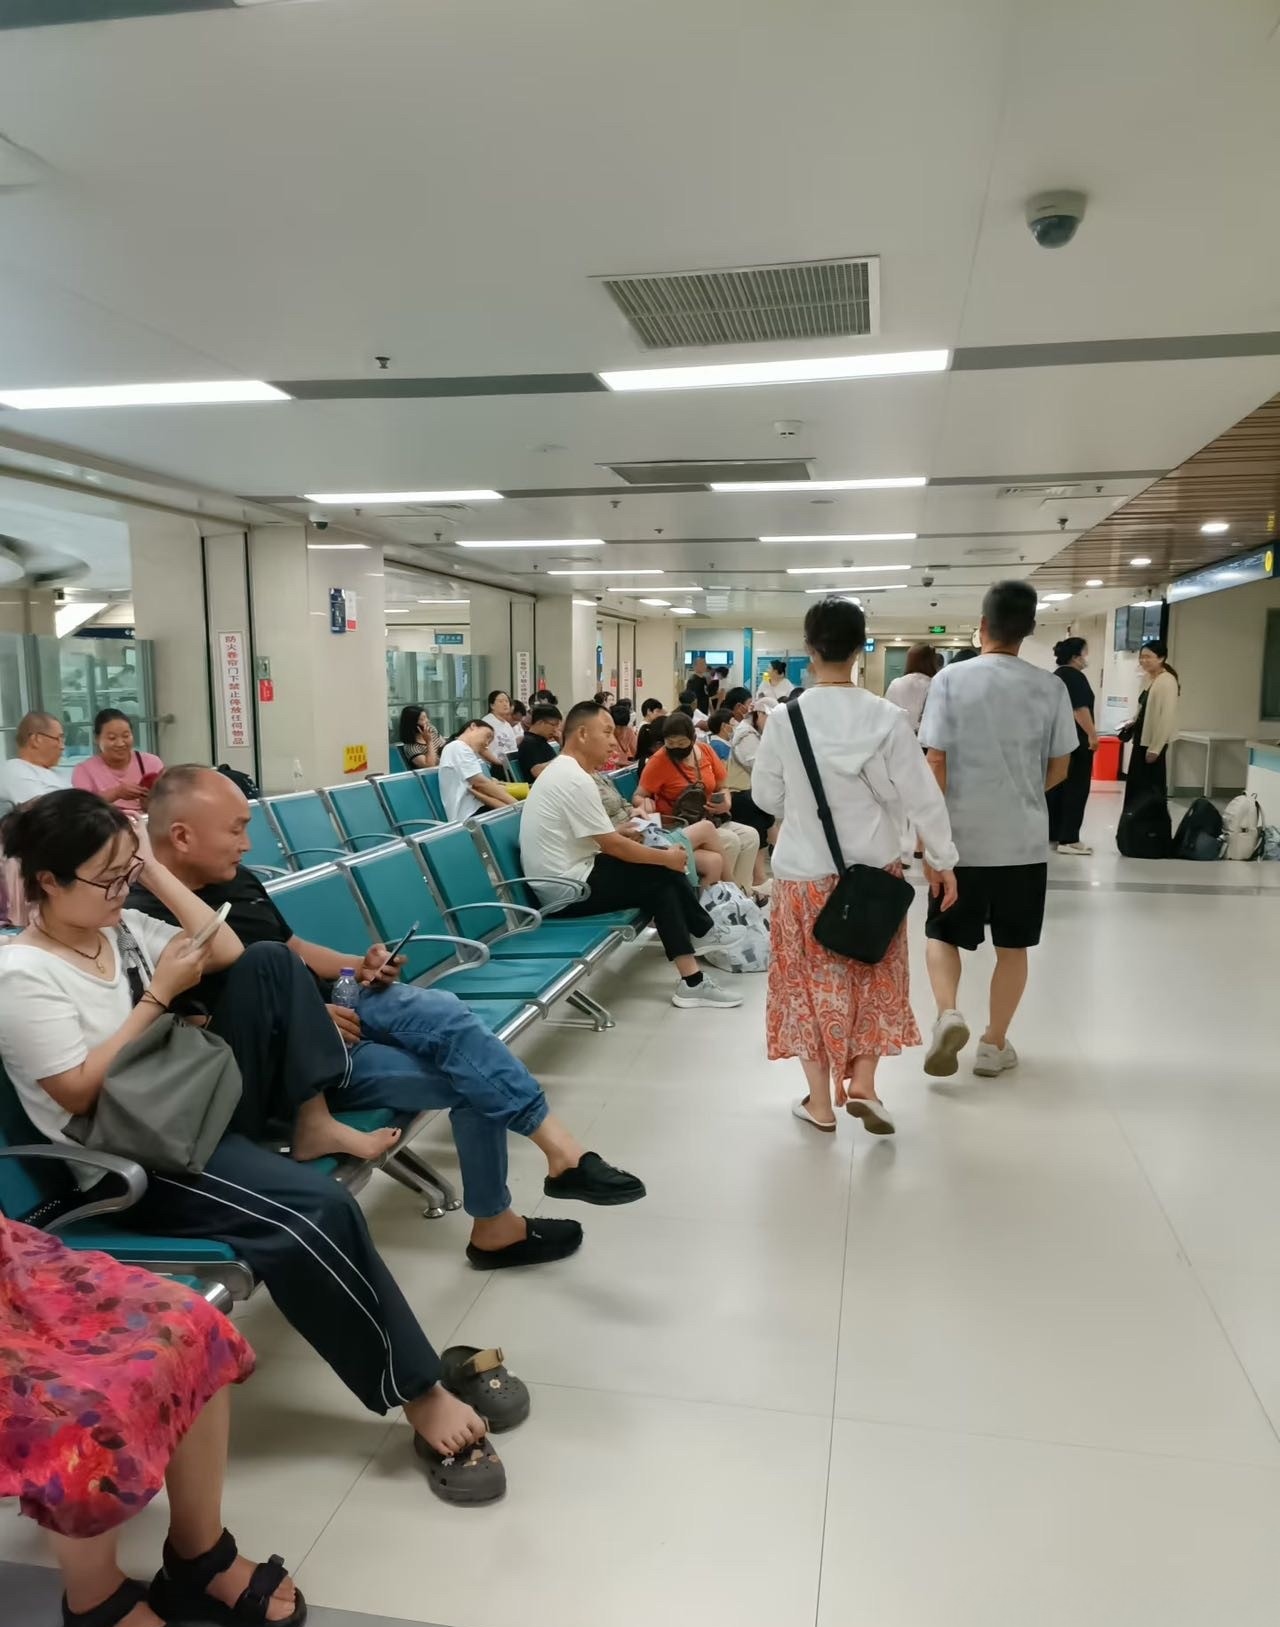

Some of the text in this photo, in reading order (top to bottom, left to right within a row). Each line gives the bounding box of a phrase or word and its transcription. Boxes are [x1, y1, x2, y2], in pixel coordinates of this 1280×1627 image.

[225, 635, 244, 745] 防火卷帘门下禁止停放任何物品
